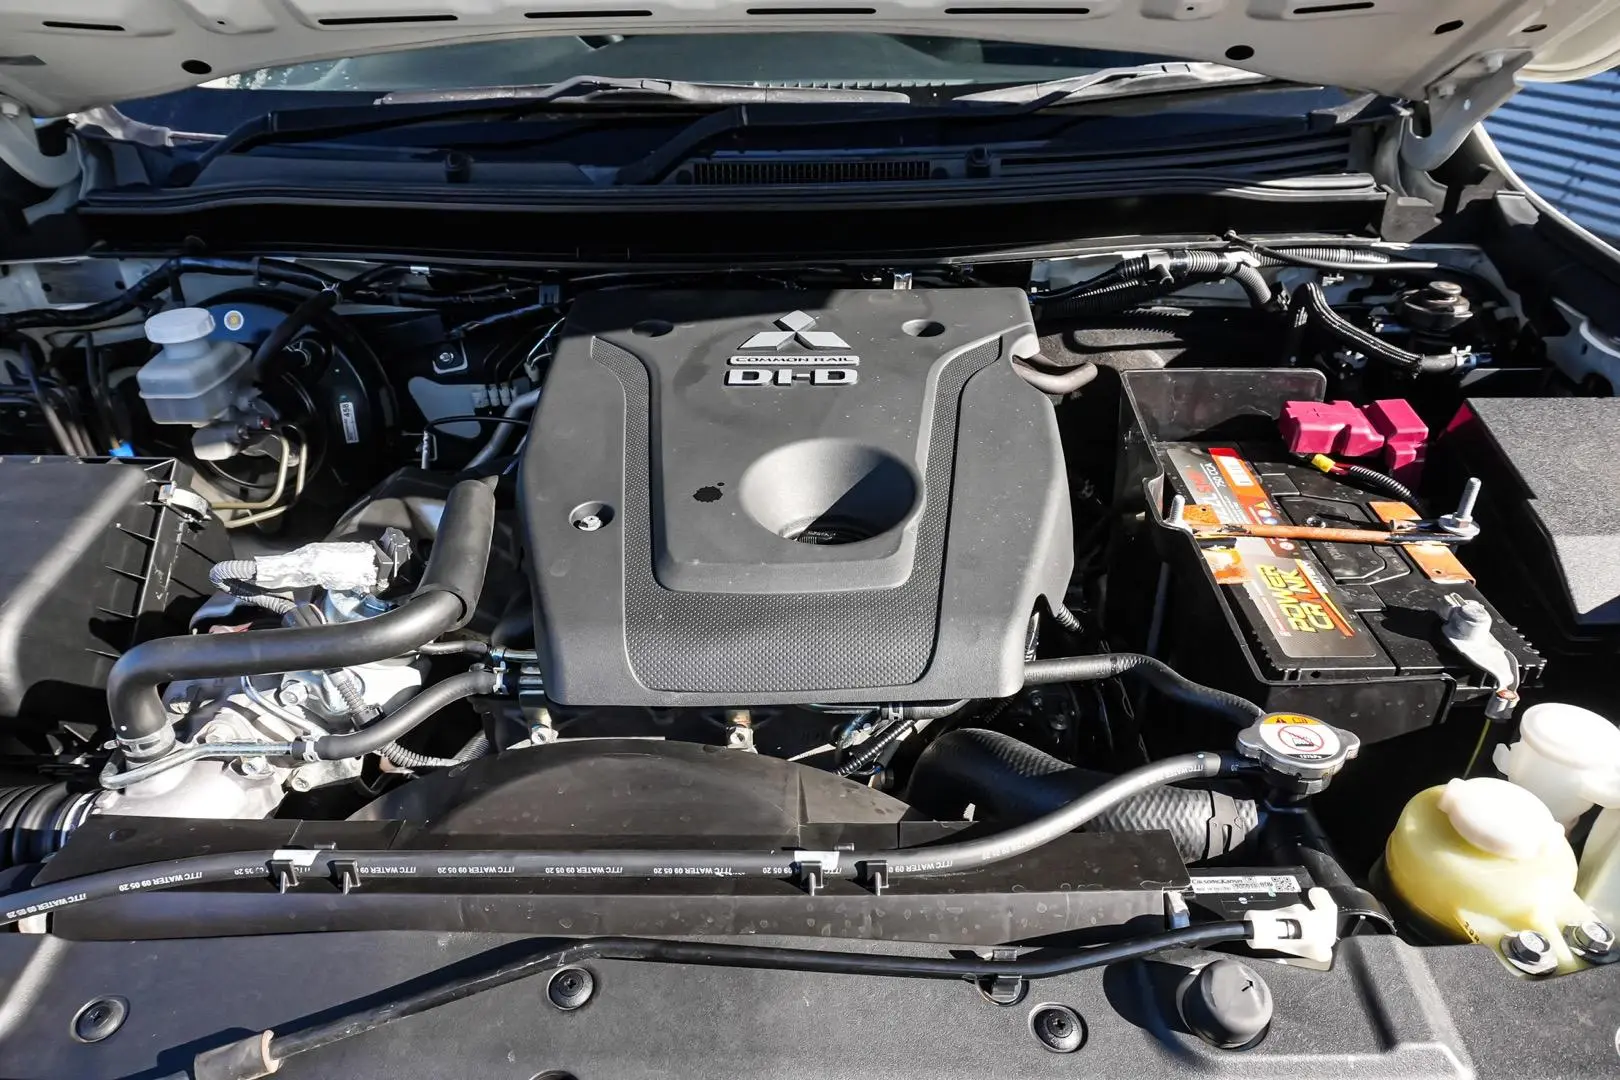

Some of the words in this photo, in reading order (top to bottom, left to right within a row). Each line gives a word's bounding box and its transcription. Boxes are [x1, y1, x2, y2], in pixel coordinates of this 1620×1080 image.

[724, 369, 859, 387] DI-D
[1256, 564, 1318, 633] POWER
[370, 866, 399, 874] WATER
[468, 866, 497, 874] WATER
[576, 866, 605, 874] WATER
[895, 865, 905, 873] 09
[905, 863, 935, 873] WATER
[141, 880, 151, 888] 09
[153, 875, 184, 886] WATER
[118, 884, 130, 892] 20
[130, 882, 140, 890] 05
[37, 898, 68, 911] WATER
